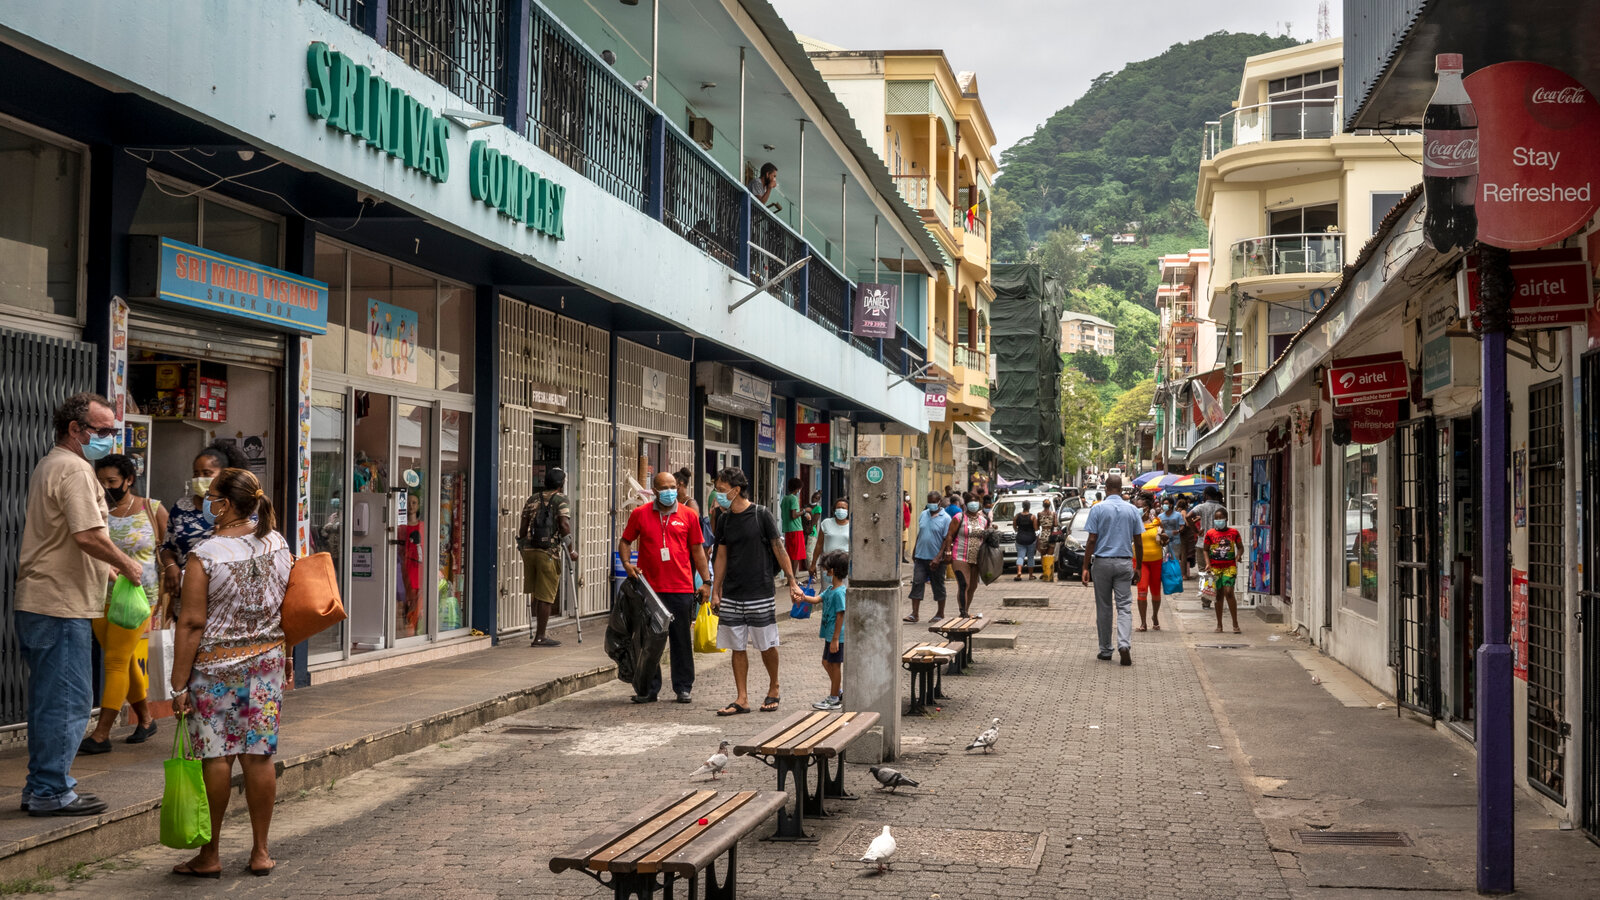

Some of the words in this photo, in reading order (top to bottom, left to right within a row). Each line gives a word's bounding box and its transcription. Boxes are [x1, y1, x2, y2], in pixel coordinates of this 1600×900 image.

[1532, 87, 1586, 104] Coca-Cola
[306, 41, 449, 183] SRINIVAS
[470, 140, 566, 241] COMPLEX
[1428, 139, 1478, 160] Coca-Cola
[1512, 146, 1560, 170] Stay
[1483, 183, 1591, 202] Refreshed
[415, 238, 420, 254] 7
[176, 253, 207, 283] SRI
[211, 263, 258, 297] MAHA
[262, 276, 319, 311] VISHNU
[1520, 278, 1566, 296] airtel
[207, 288, 256, 310] SNACK
[266, 301, 292, 317] BOX
[560, 295, 565, 309] 6
[1538, 313, 1558, 322] here!
[1359, 371, 1387, 384] airtel
[926, 394, 946, 403] FLO
[1364, 408, 1384, 417] Stay
[1353, 421, 1395, 429] Refreshed
